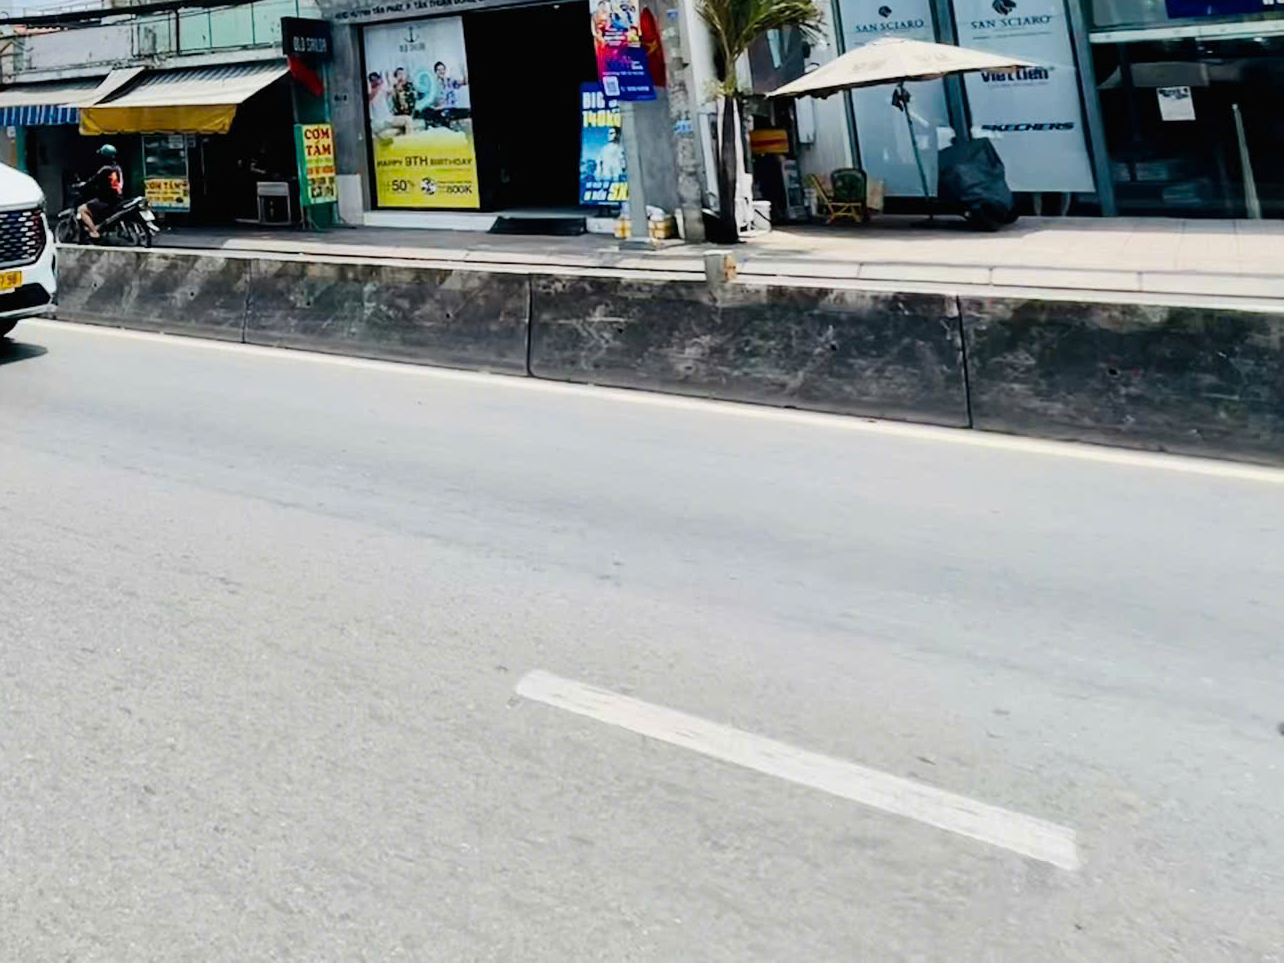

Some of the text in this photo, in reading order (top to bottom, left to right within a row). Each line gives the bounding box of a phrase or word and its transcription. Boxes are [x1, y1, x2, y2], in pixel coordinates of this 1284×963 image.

[971, 14, 1050, 30] SAN SCIARO
[856, 23, 877, 33] SAN
[981, 122, 1074, 132] SKECHERS
[404, 155, 429, 167] 9TH
[430, 157, 473, 166] BIRTHDAY
